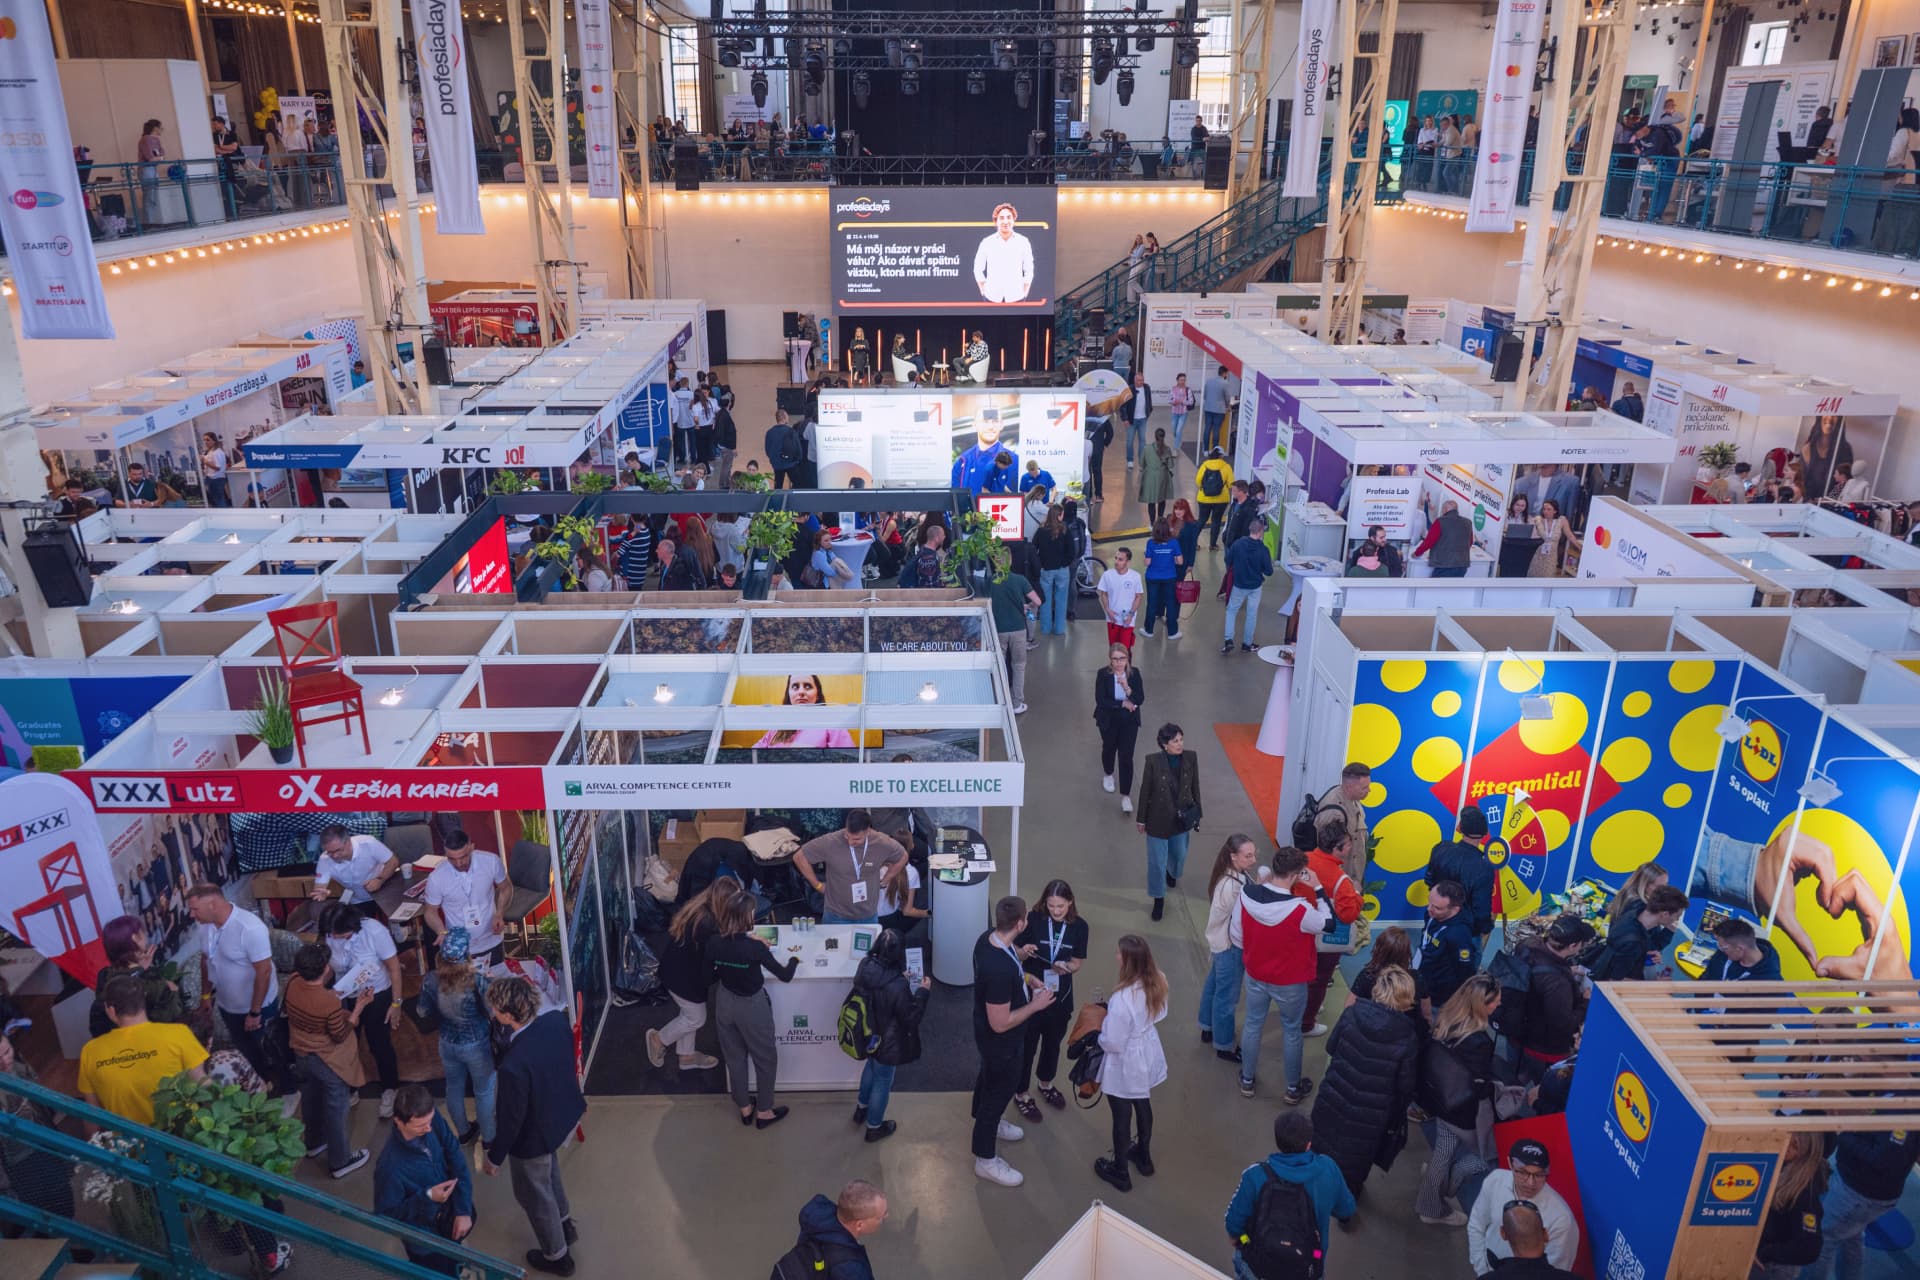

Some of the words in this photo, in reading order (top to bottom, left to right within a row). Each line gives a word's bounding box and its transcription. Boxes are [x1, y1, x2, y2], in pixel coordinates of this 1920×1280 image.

[427, 0, 457, 116] profesiaday
[1304, 28, 1324, 116] profesiadays
[837, 202, 890, 214] profesiadays
[847, 244, 862, 254] Má
[864, 244, 882, 256] môj
[885, 244, 912, 254] názor
[922, 244, 945, 256] práci
[847, 256, 875, 266] váhu?
[878, 257, 896, 266] Ako
[898, 256, 926, 266] dávať
[927, 256, 960, 268] spätnú
[848, 268, 878, 279] väzbu,
[880, 268, 905, 278] ktorá
[907, 267, 931, 277] mení
[933, 267, 958, 277] firmu
[296, 353, 310, 371] ABB
[204, 372, 269, 407] kariera.strabag.sk
[822, 402, 848, 410] TESC
[1688, 403, 1700, 412] Tu
[1816, 396, 1843, 413] H&M
[1685, 412, 1726, 422] nečakané
[584, 422, 595, 446] KFC
[1683, 422, 1730, 433] príležitosti.
[442, 448, 490, 464] KFC
[504, 445, 525, 464] JO!
[1420, 446, 1450, 457] profesia
[1627, 544, 1647, 566] IOM
[880, 642, 895, 650] WE
[896, 642, 918, 651] CARE
[920, 642, 949, 650] ABOUT
[950, 642, 968, 650] YOU
[17, 721, 62, 729] Graduates
[24, 732, 61, 740] Program
[1744, 736, 1776, 767] LIDL
[328, 780, 402, 799] LEPŠIA
[407, 780, 499, 799] KARIÉRA
[849, 780, 883, 793] RIDE
[887, 780, 906, 793] TO
[910, 779, 1002, 792] EXCELLENCE
[1471, 770, 1582, 798] #teamlidl
[1729, 775, 1740, 791] Sa
[1741, 787, 1770, 815] oplatí.
[96, 1050, 158, 1069] profesiadays
[1617, 1085, 1647, 1131] LIDL
[1604, 1120, 1614, 1141] Sa
[1614, 1136, 1640, 1180] oplatí.
[1715, 1176, 1755, 1188] LIDL
[1702, 1208, 1714, 1216] Sa
[1717, 1208, 1752, 1218] oplatí.
